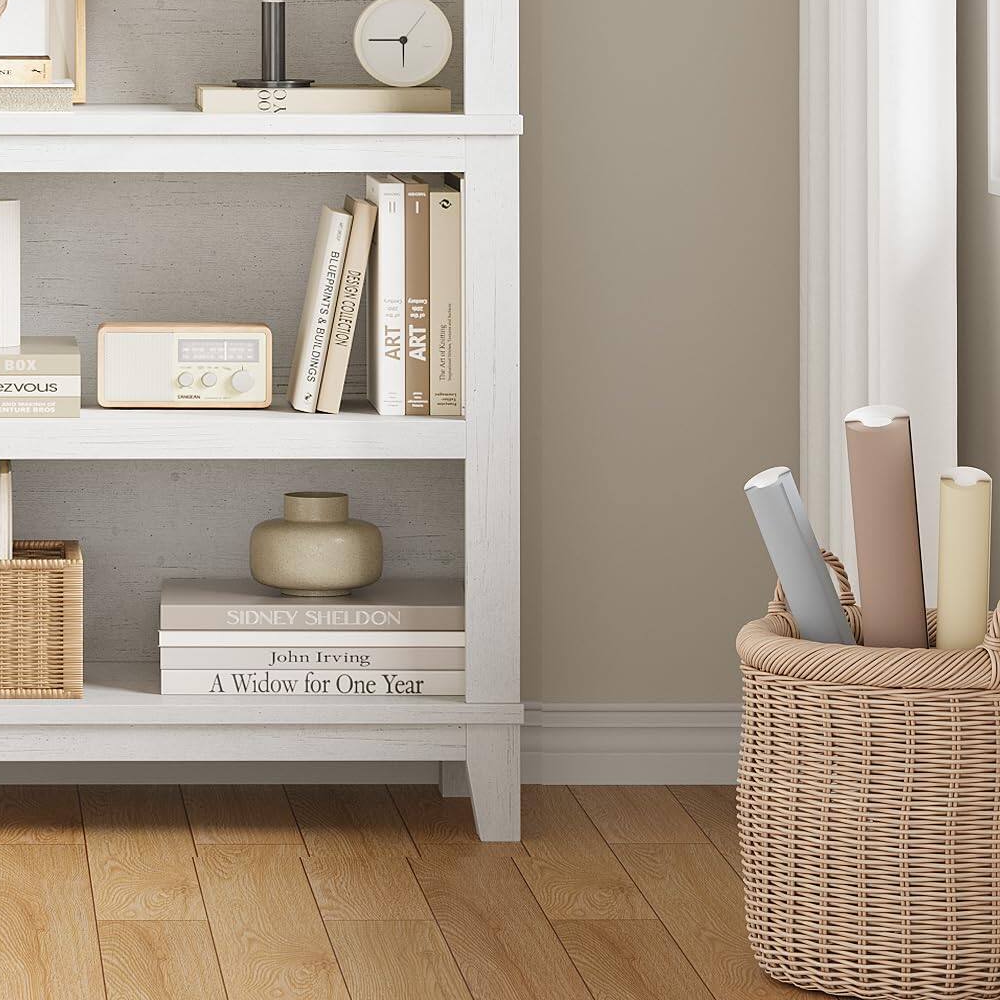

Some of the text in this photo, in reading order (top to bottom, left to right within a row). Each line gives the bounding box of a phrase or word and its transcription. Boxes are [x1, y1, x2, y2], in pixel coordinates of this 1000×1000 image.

[319, 251, 340, 315] BLUEPRINTS
[333, 270, 362, 347] DESIGN COLLECTION
[385, 325, 400, 361] ART
[408, 324, 426, 361] ART
[438, 324, 447, 349] Knitting
[5, 360, 38, 371] BOX
[306, 327, 324, 383] BUILDINGS
[438, 370, 446, 381] The
[226, 610, 401, 625] SIDNEY SHELDON
[268, 651, 371, 667] John Irving
[209, 672, 425, 694] A Widow for One Year
